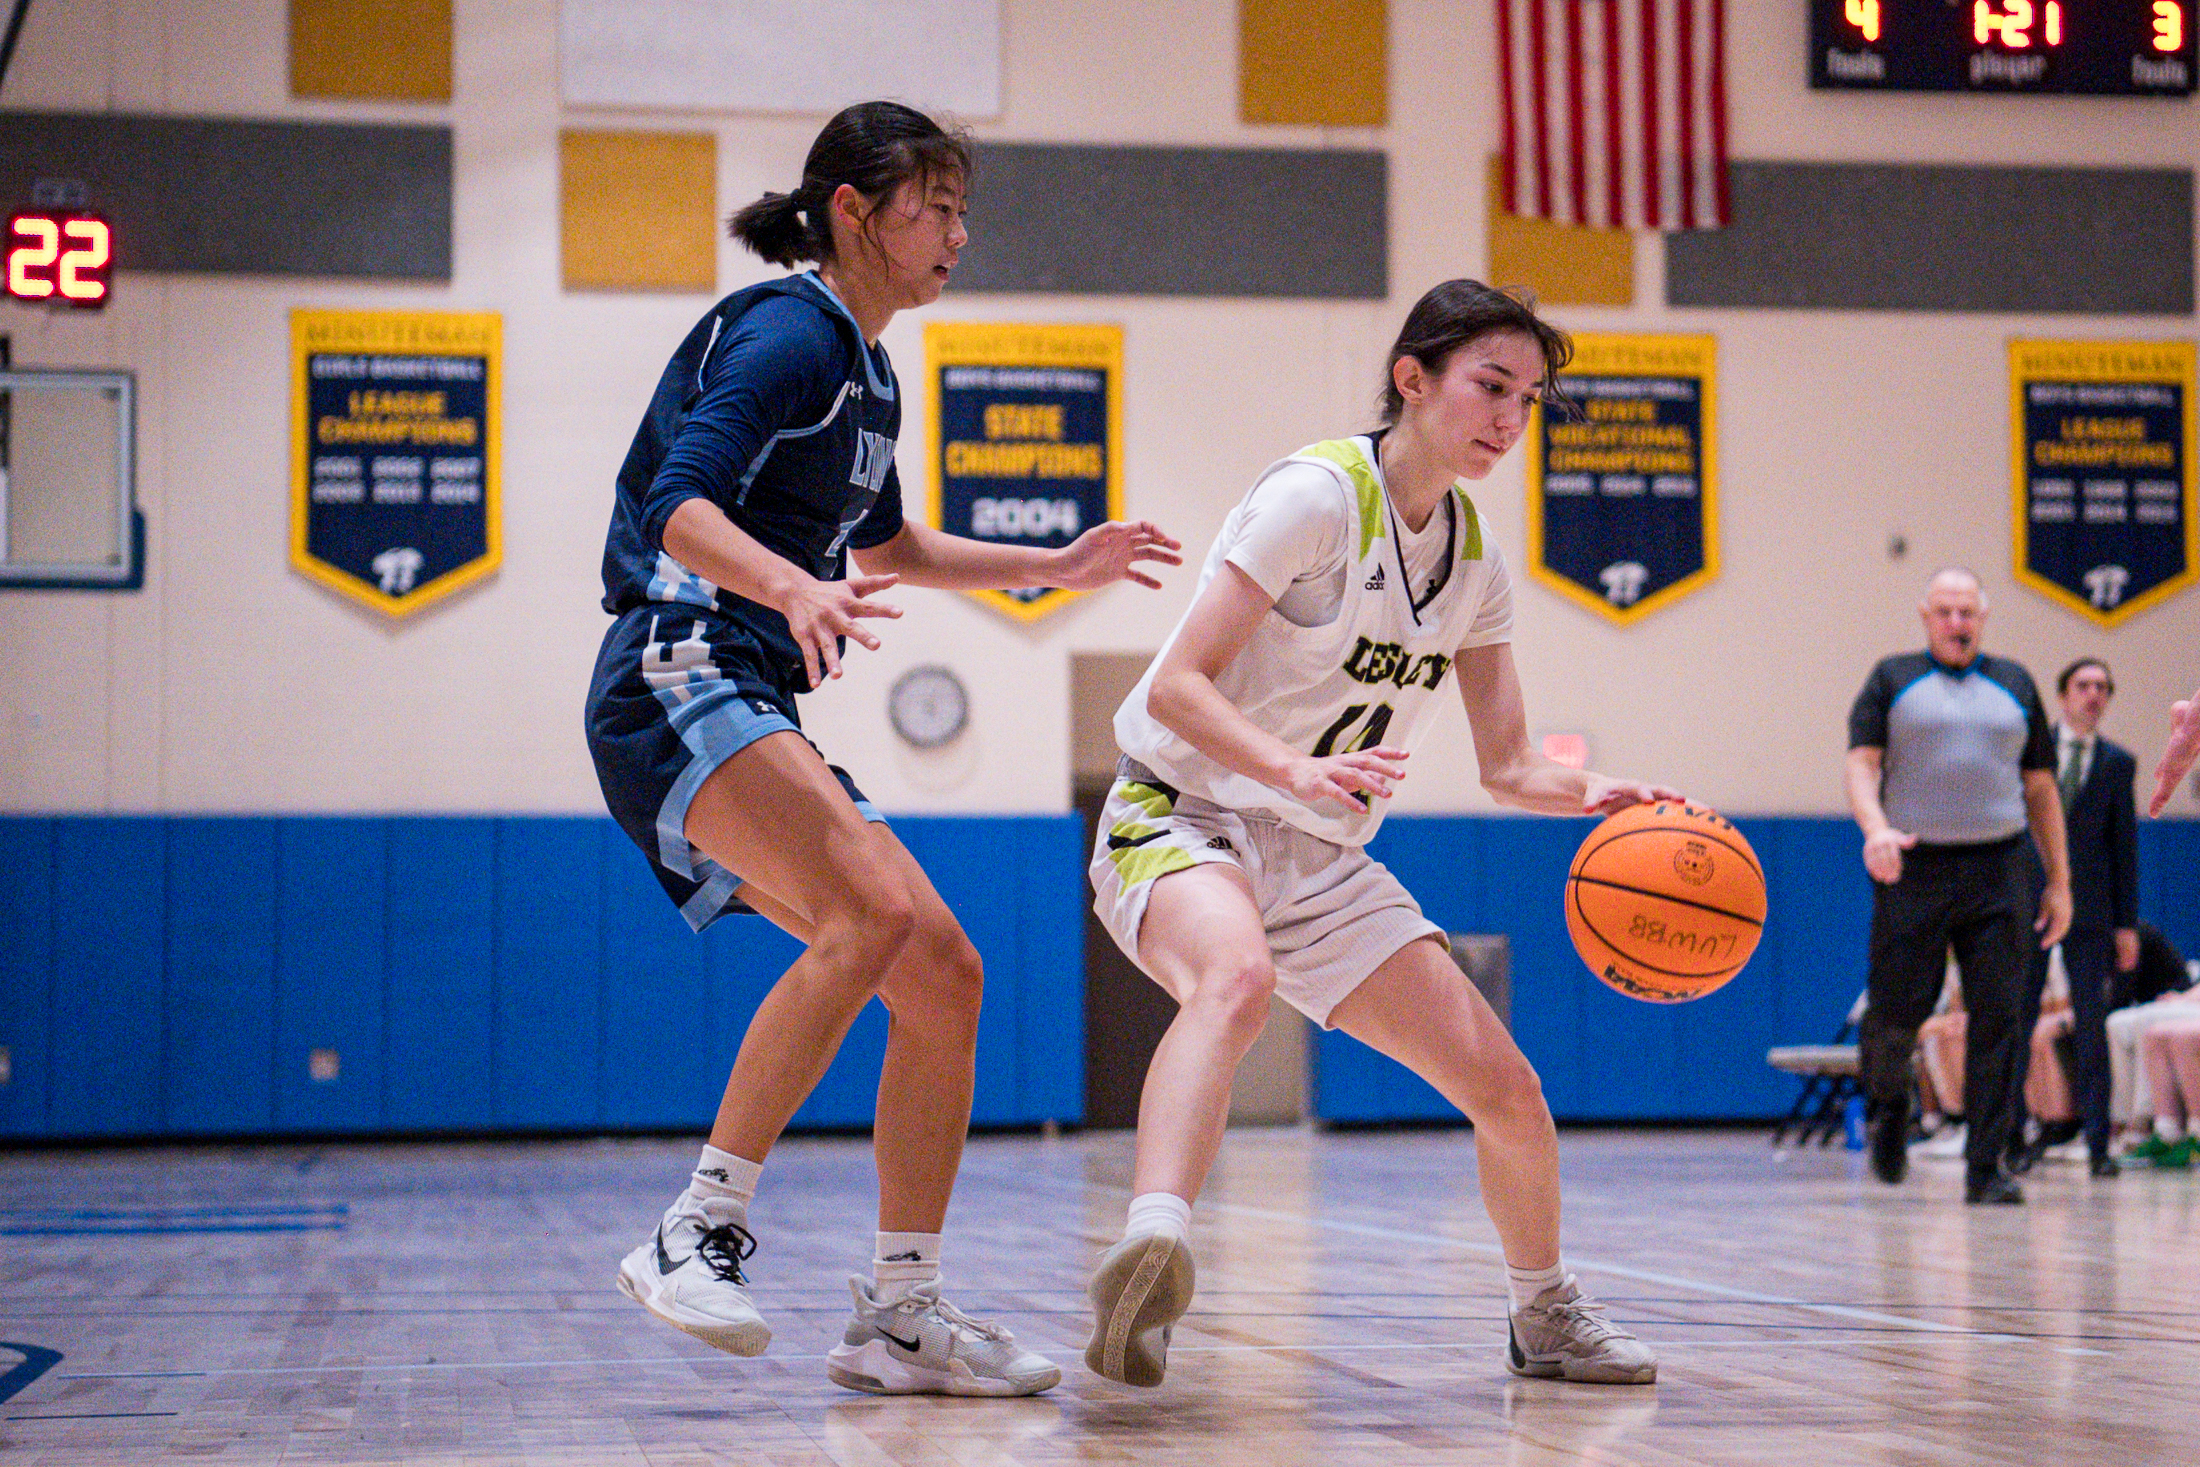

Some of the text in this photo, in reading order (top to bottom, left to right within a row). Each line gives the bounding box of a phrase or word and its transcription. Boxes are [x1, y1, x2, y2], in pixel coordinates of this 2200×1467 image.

[2152, 0, 2182, 51] 3
[9, 217, 109, 299] 22
[349, 390, 446, 414] LEAGUE
[1585, 400, 1656, 422] STATE
[318, 416, 477, 444] CHAMPIONS
[984, 403, 1062, 439] STATE
[2060, 416, 2145, 440] LEAGUE
[945, 440, 1103, 478] CHAMPIONS
[1549, 450, 1695, 474] CHAMPIONS
[2033, 440, 2174, 467] CHAMPIONS
[971, 497, 1080, 537] 2004
